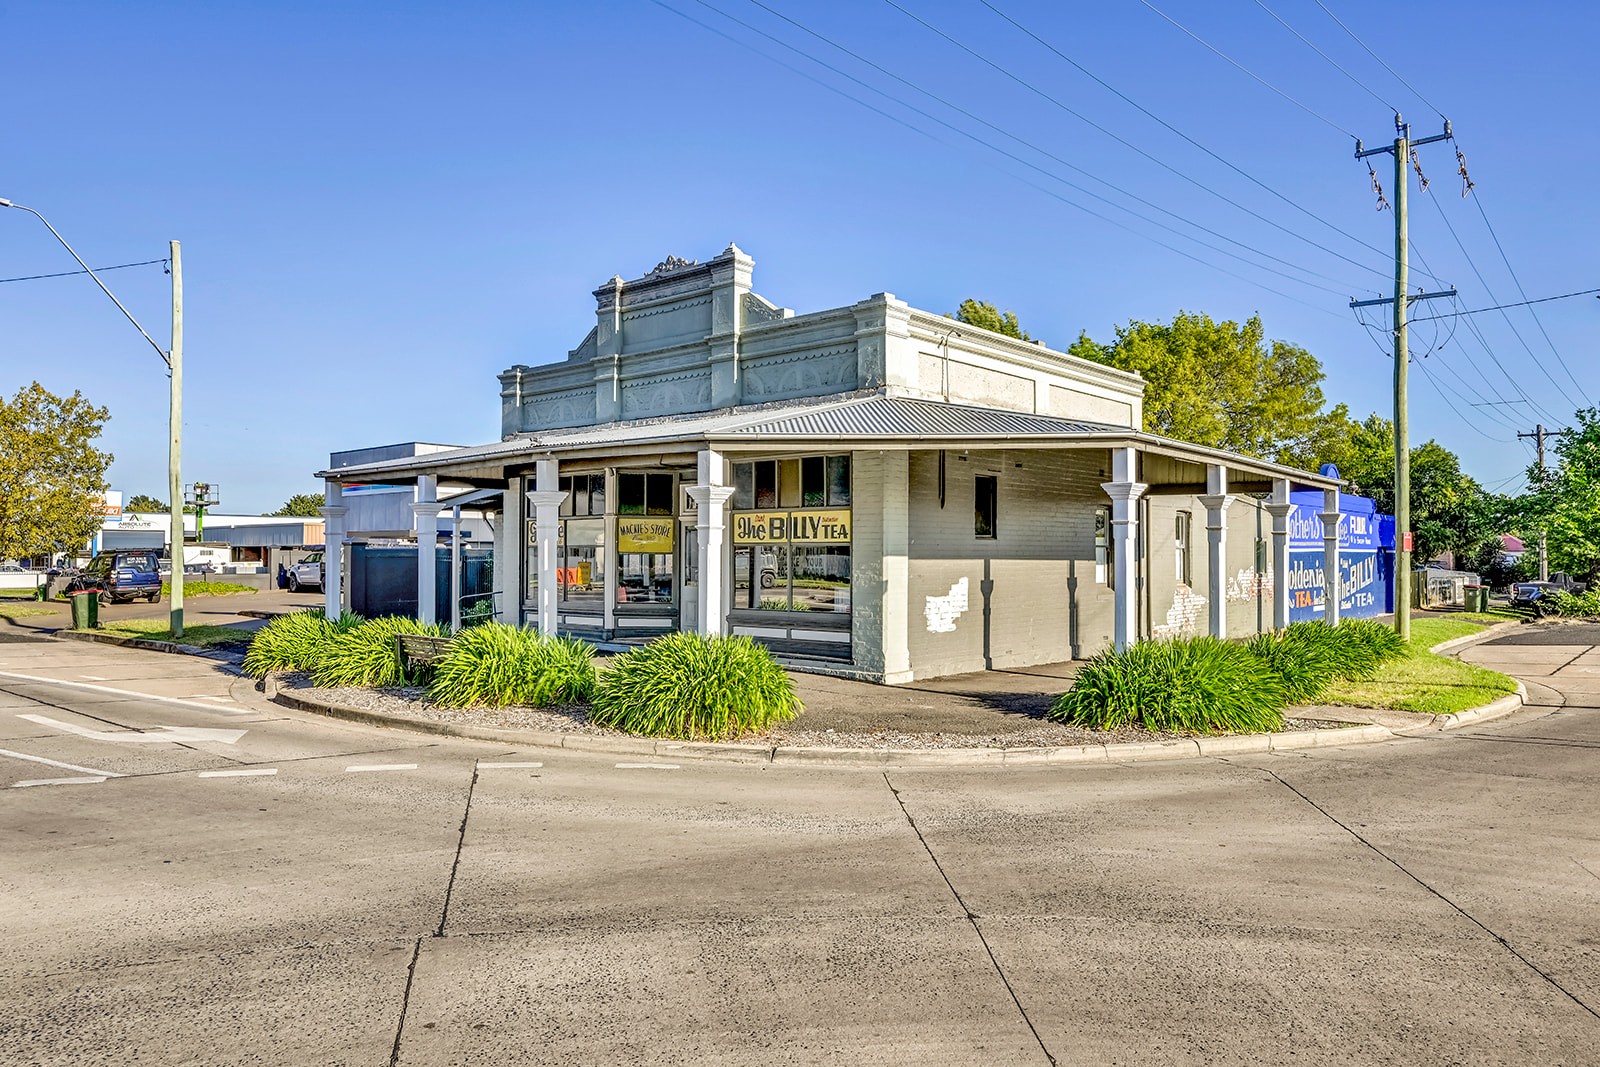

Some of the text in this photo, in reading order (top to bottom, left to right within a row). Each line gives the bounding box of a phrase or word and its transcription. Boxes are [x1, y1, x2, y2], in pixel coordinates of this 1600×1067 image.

[620, 521, 649, 536] MACKIE'S
[650, 524, 671, 538] STORE
[769, 516, 821, 539] BILLY
[822, 524, 848, 539] TEA
[1290, 509, 1320, 539] other's
[1289, 560, 1326, 590] oldenia
[1350, 555, 1375, 595] BILLY
[1355, 592, 1373, 607] TEA
